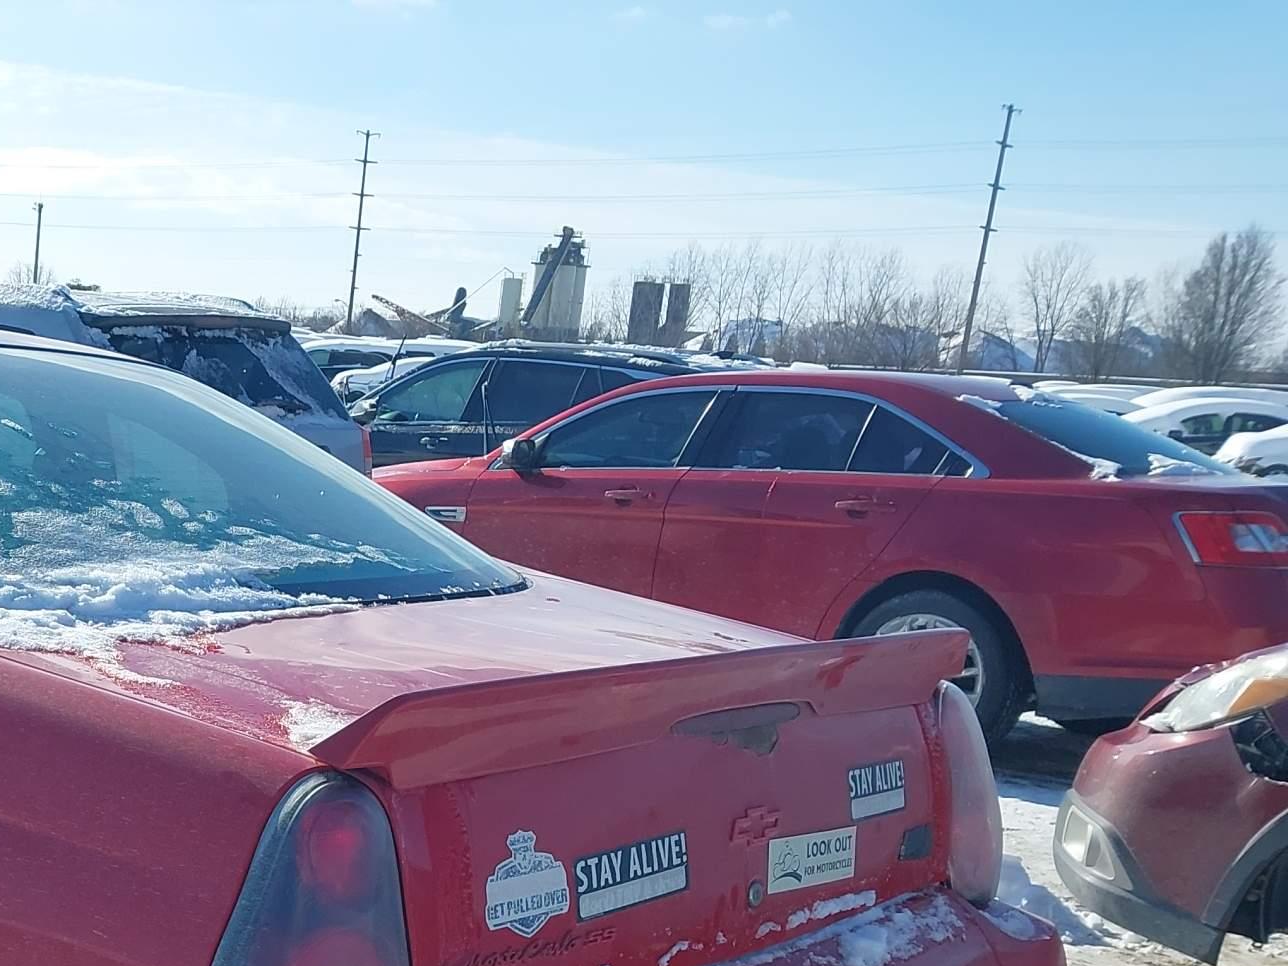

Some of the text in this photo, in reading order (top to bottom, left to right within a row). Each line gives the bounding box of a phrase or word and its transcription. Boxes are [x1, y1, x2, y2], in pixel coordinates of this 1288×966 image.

[848, 759, 905, 797] STAY ALIVE!
[806, 834, 853, 859] LOOK OUT
[576, 850, 623, 893] STAY
[629, 832, 688, 879] ALIVE!
[804, 865, 815, 877] FOR
[506, 893, 543, 917] PULLED
[543, 887, 568, 908] OVER
[583, 926, 617, 946] SS
